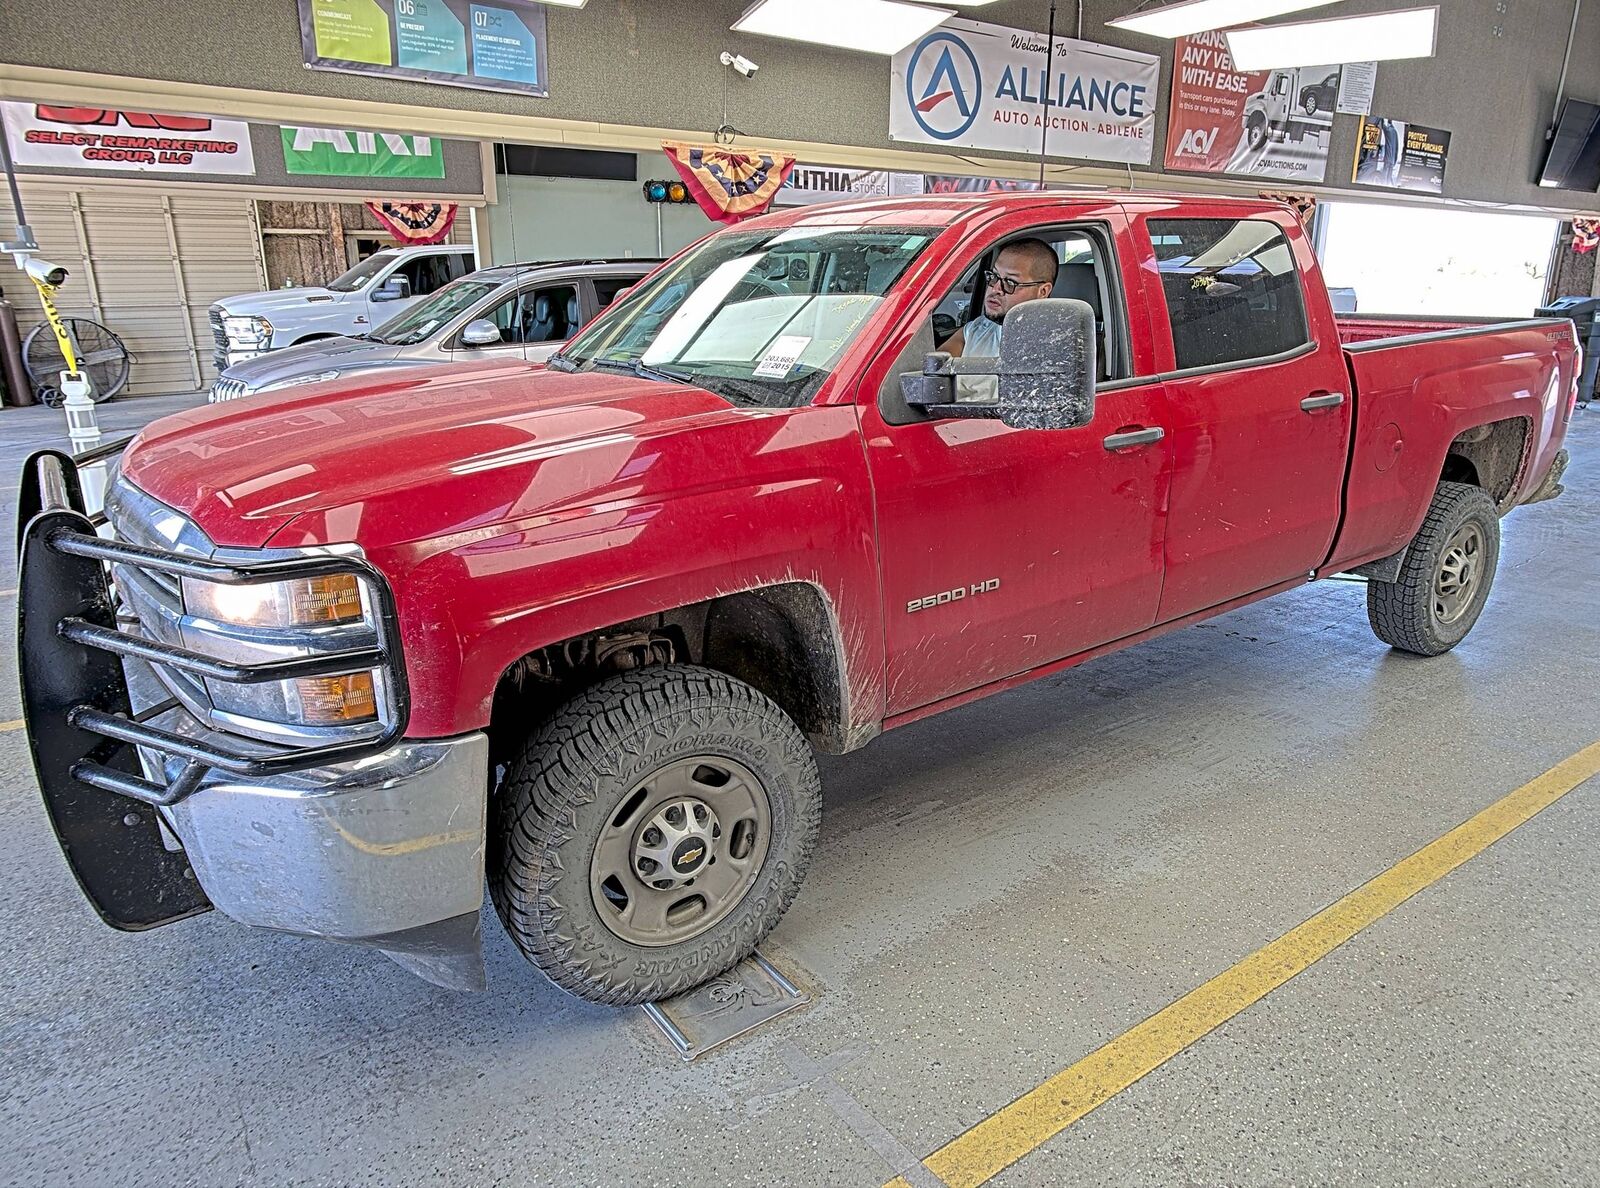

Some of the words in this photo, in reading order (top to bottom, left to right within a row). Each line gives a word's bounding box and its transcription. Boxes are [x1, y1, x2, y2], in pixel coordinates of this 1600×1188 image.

[399, 0, 415, 15] 06
[475, 11, 487, 27] 07
[1056, 42, 1067, 57] To
[1182, 47, 1212, 67] ANY
[1182, 66, 1215, 88] WITH
[1215, 73, 1248, 93] EASE.
[995, 65, 1146, 118] ALLIANCE
[1180, 90, 1202, 101] Transport
[1213, 97, 1238, 106] purchased
[1184, 102, 1194, 110] this
[1200, 105, 1209, 114] any
[993, 110, 1029, 125] AUTO
[1034, 115, 1089, 132] AUCTION
[25, 130, 99, 147] SELECT
[101, 133, 238, 154] REMARKETING
[1174, 127, 1220, 157] ACV
[1407, 131, 1428, 142] PROTECT
[1406, 140, 1422, 151] EVERY
[82, 148, 156, 165] GROUP,
[158, 151, 193, 165] LLC
[793, 169, 852, 193] LITHIA
[853, 184, 886, 195] STORES
[770, 362, 790, 371] 2015
[907, 587, 967, 613] 2500
[970, 578, 1000, 595] HD
[615, 733, 767, 787] YOKOHAMA
